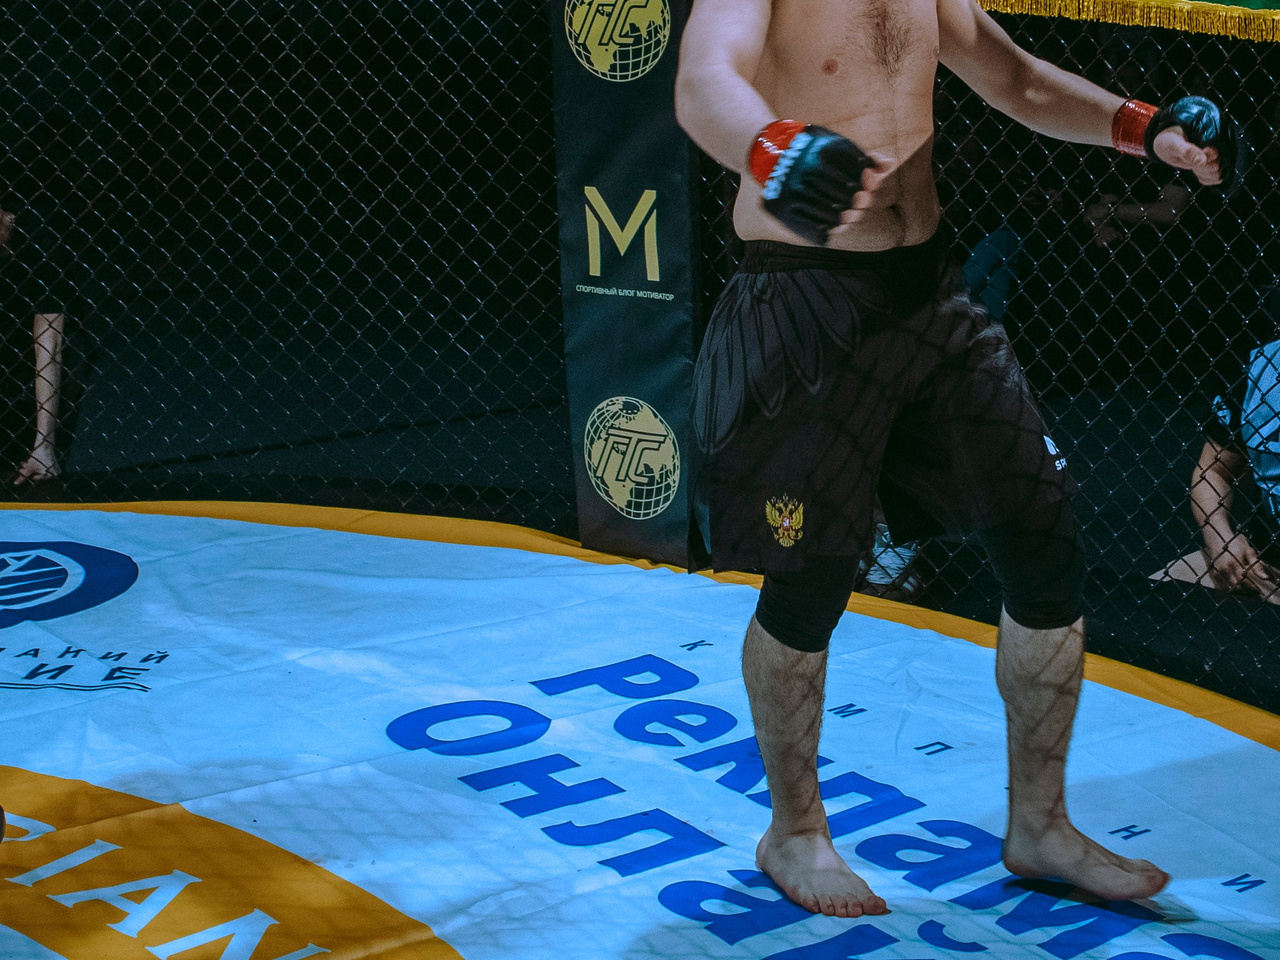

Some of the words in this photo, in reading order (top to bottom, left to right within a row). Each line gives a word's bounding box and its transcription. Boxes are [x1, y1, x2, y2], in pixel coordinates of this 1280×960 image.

[575, 284, 618, 296] СПОРТИВНЫЙ
[618, 289, 635, 297] БЛОГ
[636, 290, 675, 301] МОТИВАТОР
